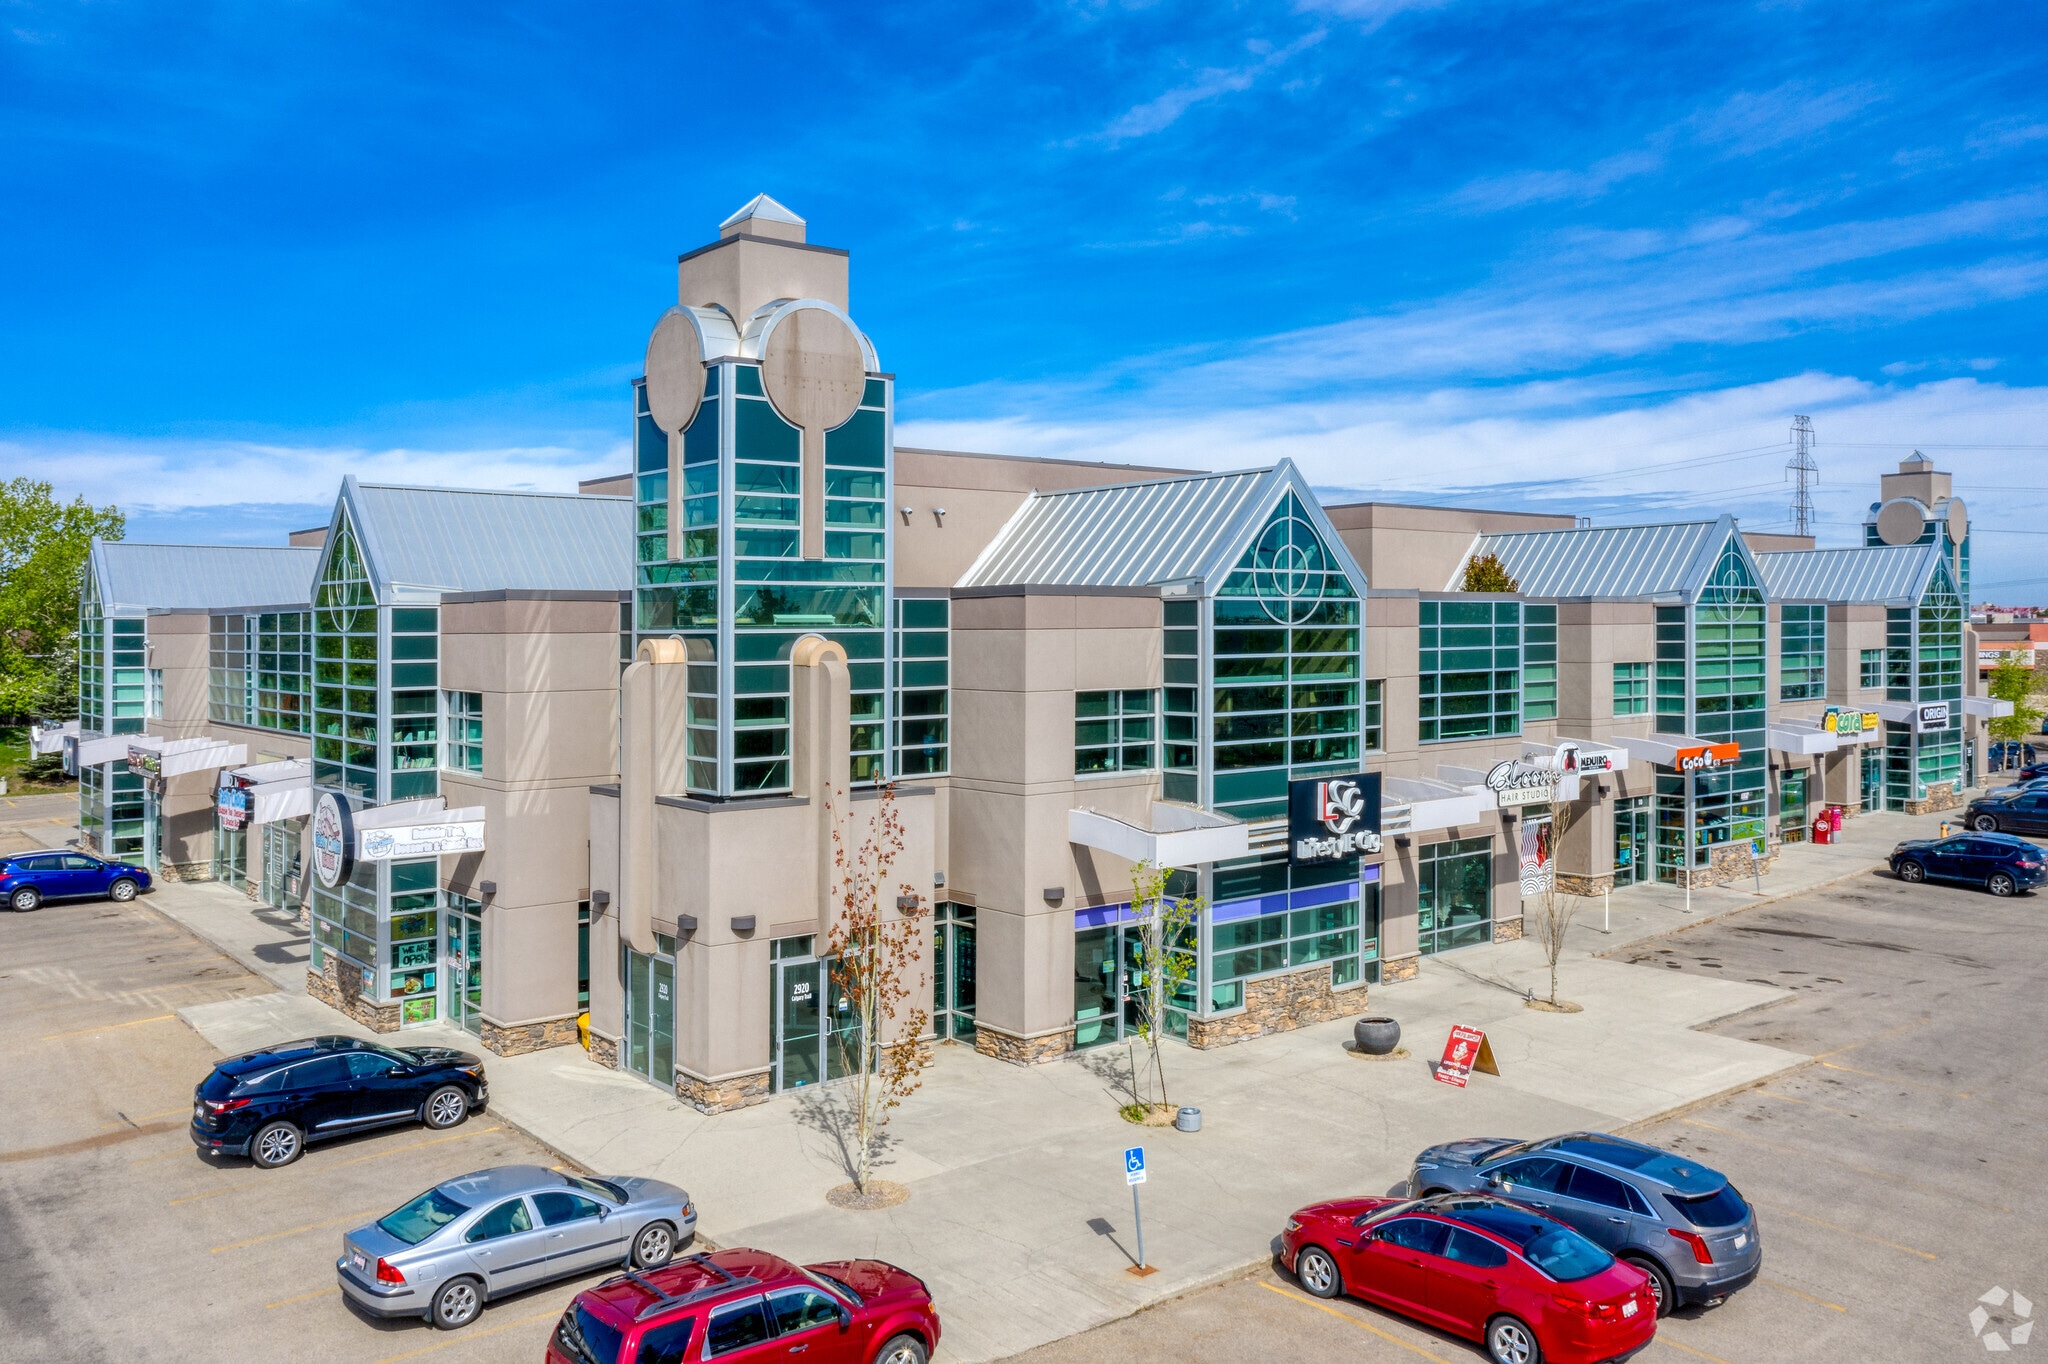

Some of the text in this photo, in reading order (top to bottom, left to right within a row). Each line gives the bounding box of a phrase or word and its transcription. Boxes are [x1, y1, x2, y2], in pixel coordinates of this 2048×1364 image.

[1923, 706, 1947, 720] ORIGIN
[1486, 759, 1562, 792] Bloom
[1501, 788, 1549, 803] HAIR STUDIO
[402, 946, 415, 954] WE
[403, 953, 428, 966] OPEN
[793, 982, 810, 995] 2920
